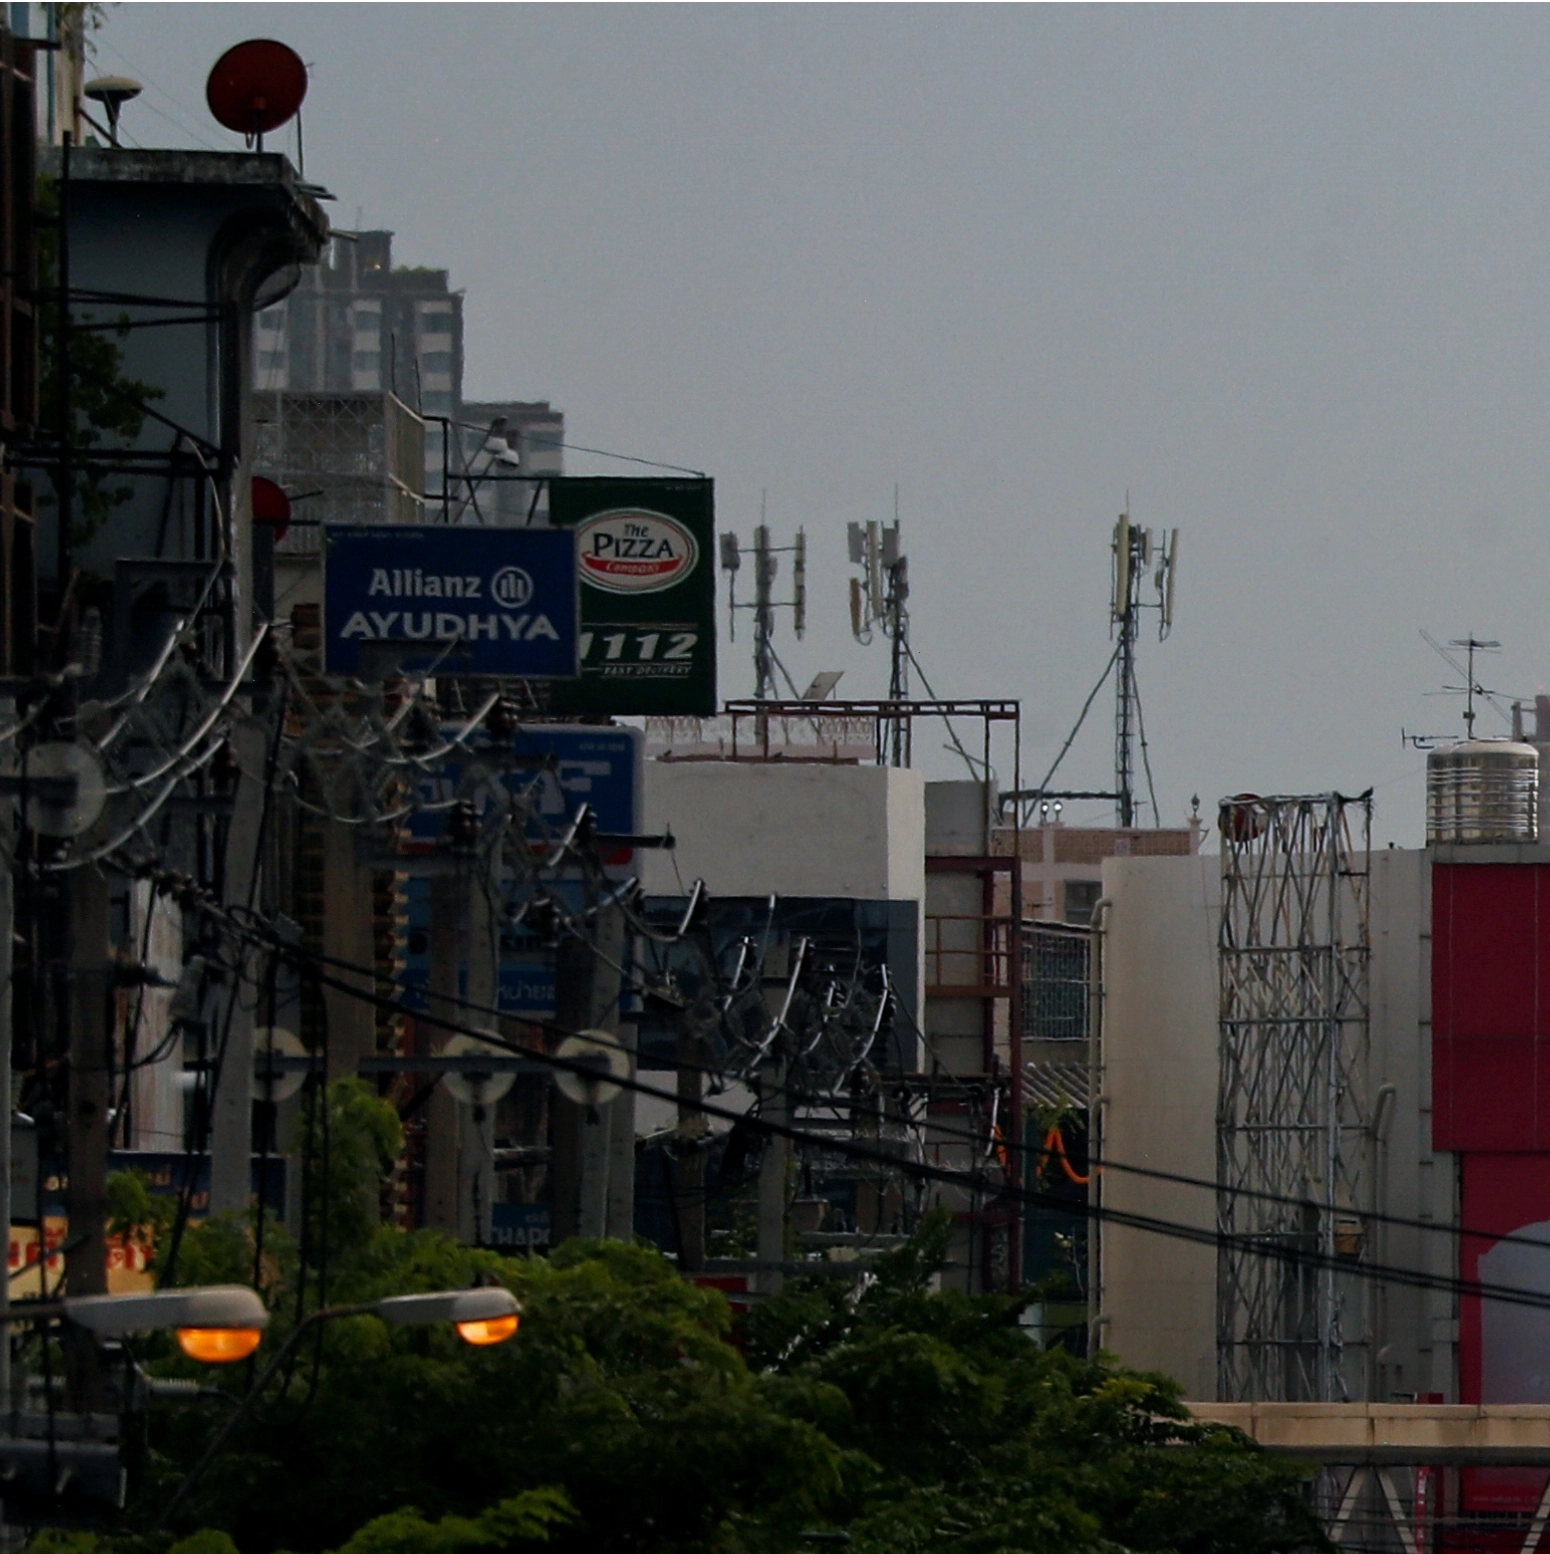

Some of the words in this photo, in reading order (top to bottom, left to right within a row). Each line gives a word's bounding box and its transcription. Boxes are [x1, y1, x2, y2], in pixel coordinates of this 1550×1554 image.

[624, 523, 649, 538] The
[593, 533, 676, 560] PIZZA
[367, 567, 482, 601] Allianz
[339, 611, 561, 641] AYUDHYA
